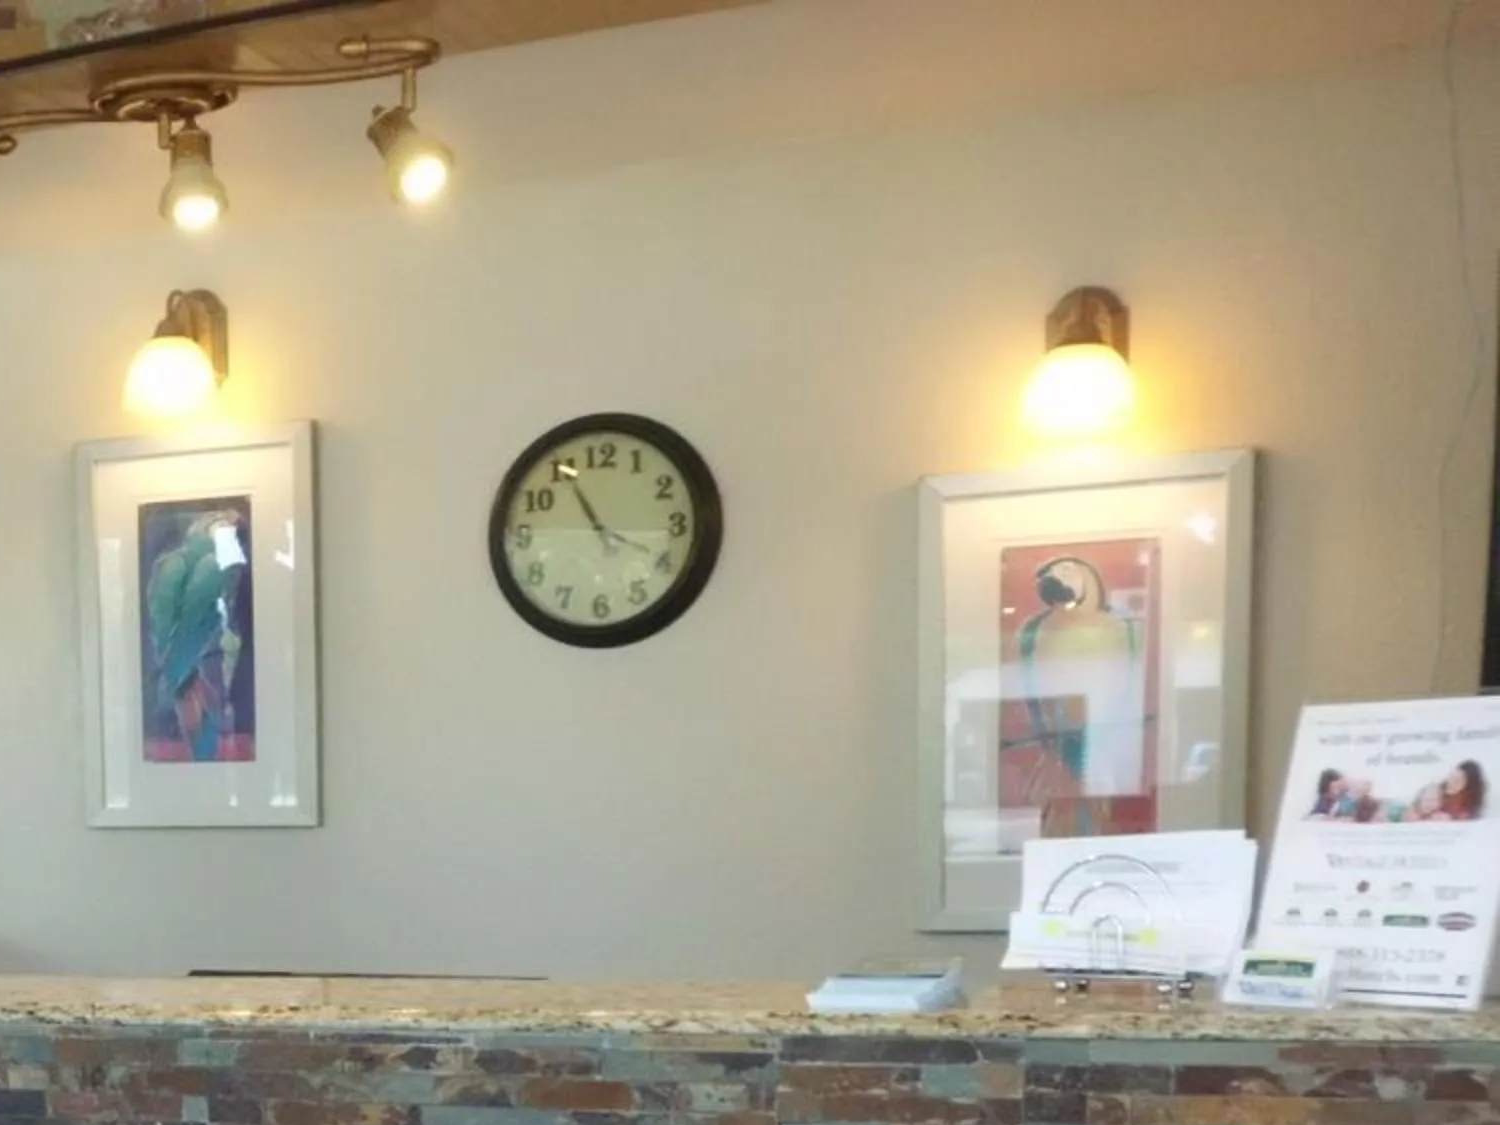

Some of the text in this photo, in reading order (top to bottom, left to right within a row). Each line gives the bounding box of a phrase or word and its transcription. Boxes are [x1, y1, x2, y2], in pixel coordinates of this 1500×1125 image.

[585, 443, 617, 469] 12
[629, 450, 643, 474] 1
[549, 458, 577, 483] 11
[655, 475, 674, 500] 2
[524, 488, 554, 513] 10
[516, 524, 532, 549] 9
[668, 512, 687, 537] 3
[526, 562, 544, 586] 8
[555, 586, 573, 609] 7
[628, 580, 647, 604] 5
[592, 594, 610, 618] 6
